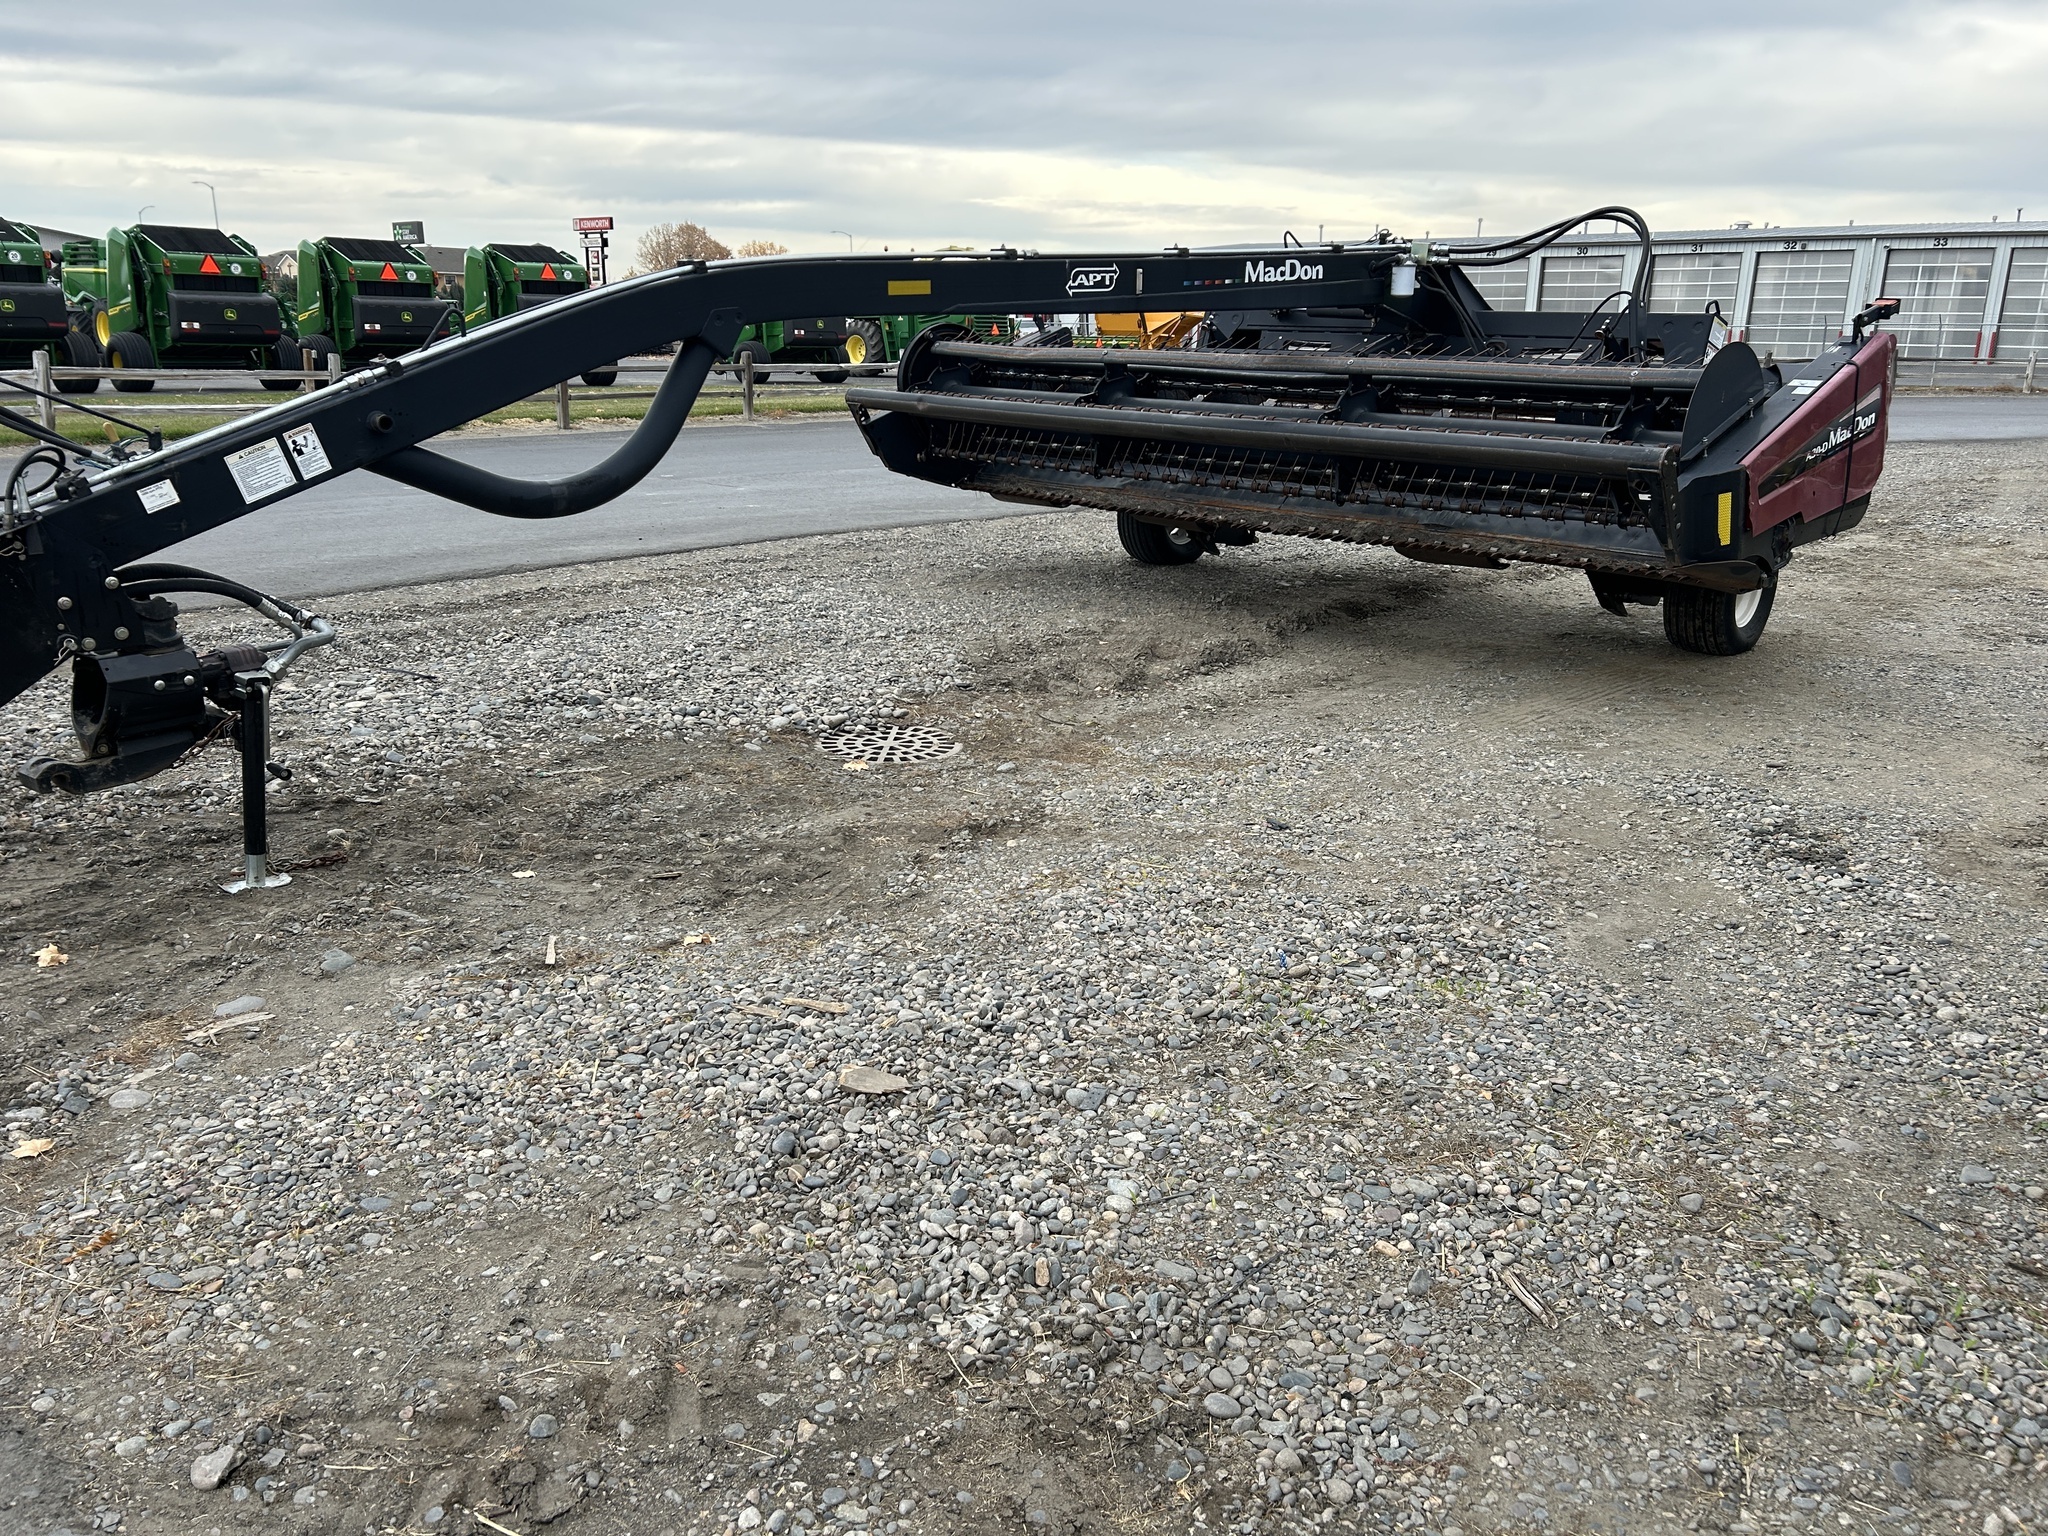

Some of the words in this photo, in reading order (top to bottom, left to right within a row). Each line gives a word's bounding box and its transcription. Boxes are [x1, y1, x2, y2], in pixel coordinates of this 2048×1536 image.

[581, 220, 609, 228] KENWORTH
[1784, 241, 1797, 249] 32
[1933, 237, 1948, 247] 33
[1576, 247, 1589, 255] 30
[1691, 244, 1704, 252] 31
[1244, 259, 1324, 283] MacDon
[1074, 273, 1115, 286] APT
[243, 445, 266, 457] CAUTION
